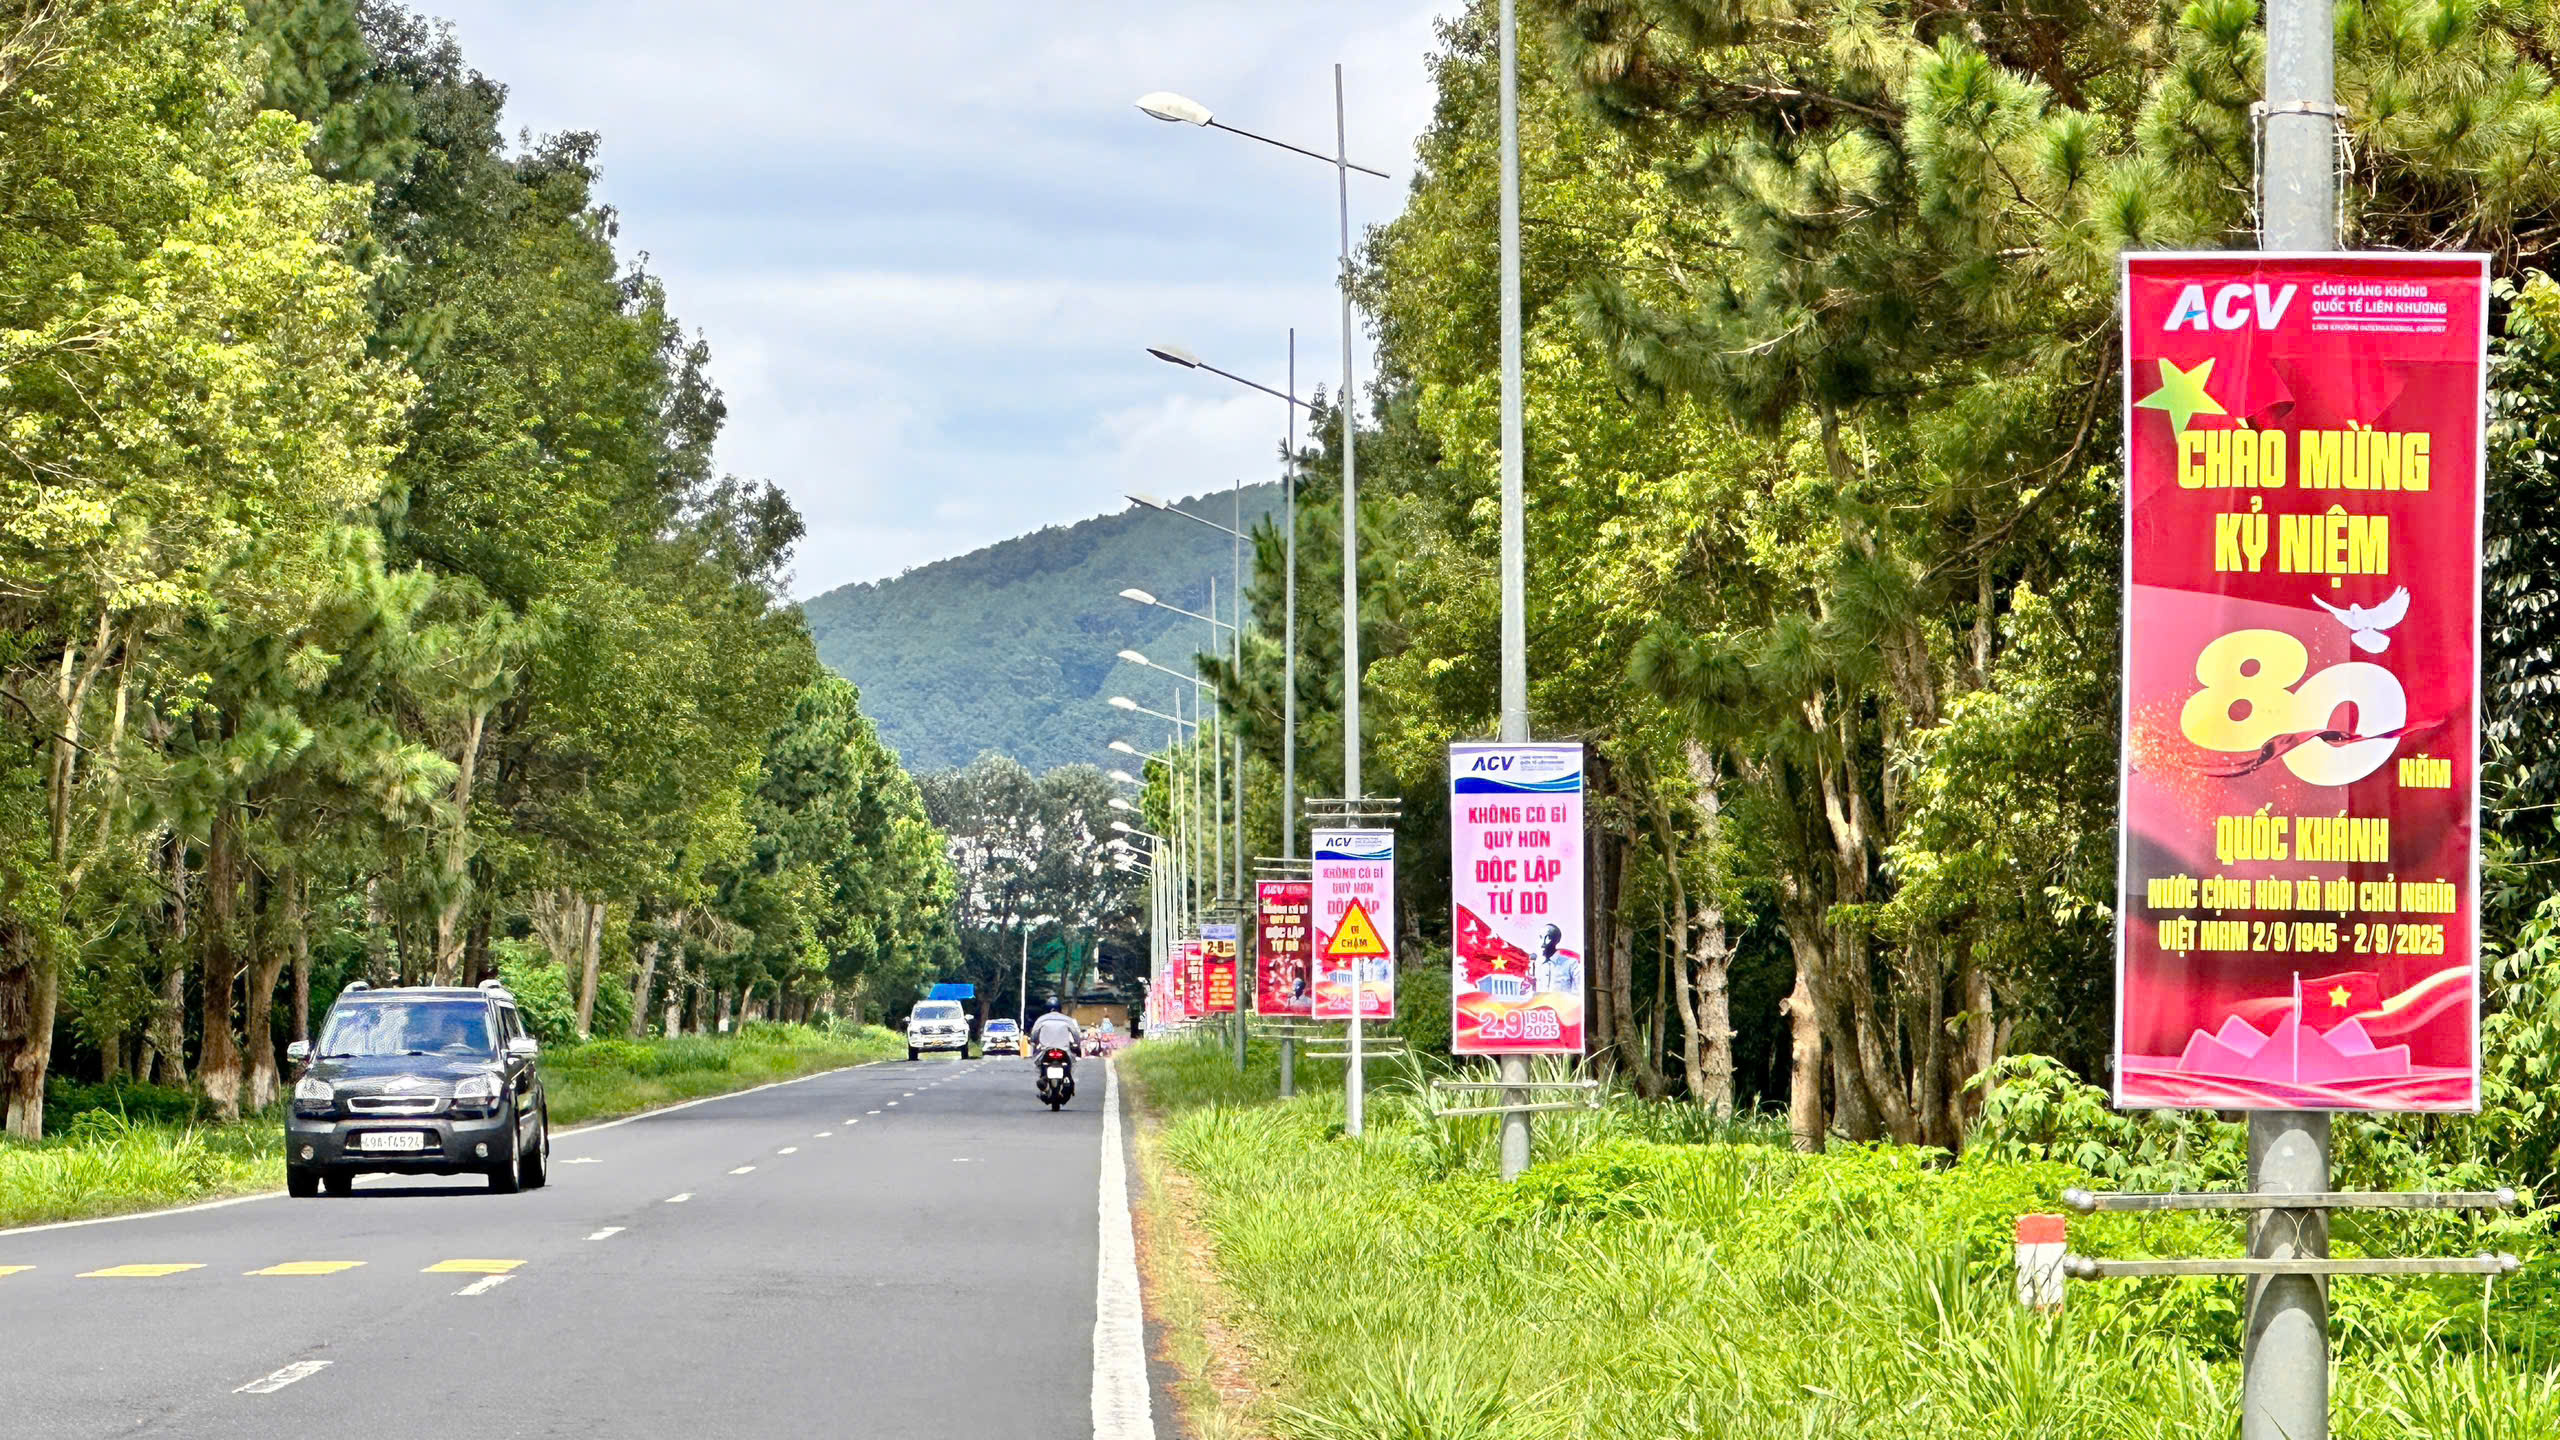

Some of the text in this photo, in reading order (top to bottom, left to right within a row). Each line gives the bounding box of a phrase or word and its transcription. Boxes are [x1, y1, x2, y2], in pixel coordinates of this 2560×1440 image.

[2385, 283, 2428, 298] KHÔNG
[2163, 284, 2297, 331] ACV
[2312, 297, 2346, 314] QUỐC
[2348, 298, 2364, 313] TẾ
[2366, 299, 2394, 313] LIÊN
[2178, 417, 2431, 491] CHÀO MỪNG
[2215, 495, 2389, 588] KỶ NIỆM
[2180, 628, 2406, 786] 80
[1472, 756, 1514, 771] ACV
[2399, 753, 2451, 788] NĂM
[1468, 802, 1566, 824] KHÔNG CÓ GÌ
[1326, 837, 1352, 847] ACV
[1518, 829, 1550, 848] HƠN
[2216, 802, 2389, 865] QUỐC KHÁNH
[1475, 855, 1561, 888] ĐỘC LẬP
[1487, 888, 1548, 920] TỰ DO
[2147, 873, 2456, 918] NƯỚC CỘNG HÒA XÃ HỘI CHỦ NGHĨA
[1341, 937, 1368, 949] CHẬM
[2158, 915, 2197, 958] VIỆT
[2252, 921, 2337, 953] 2/9/1945
[2354, 923, 2444, 955] 2/9/2025
[1480, 1011, 1522, 1037] 2.9
[1525, 1024, 1558, 1038] 2025
[1526, 1011, 1555, 1024] 1945
